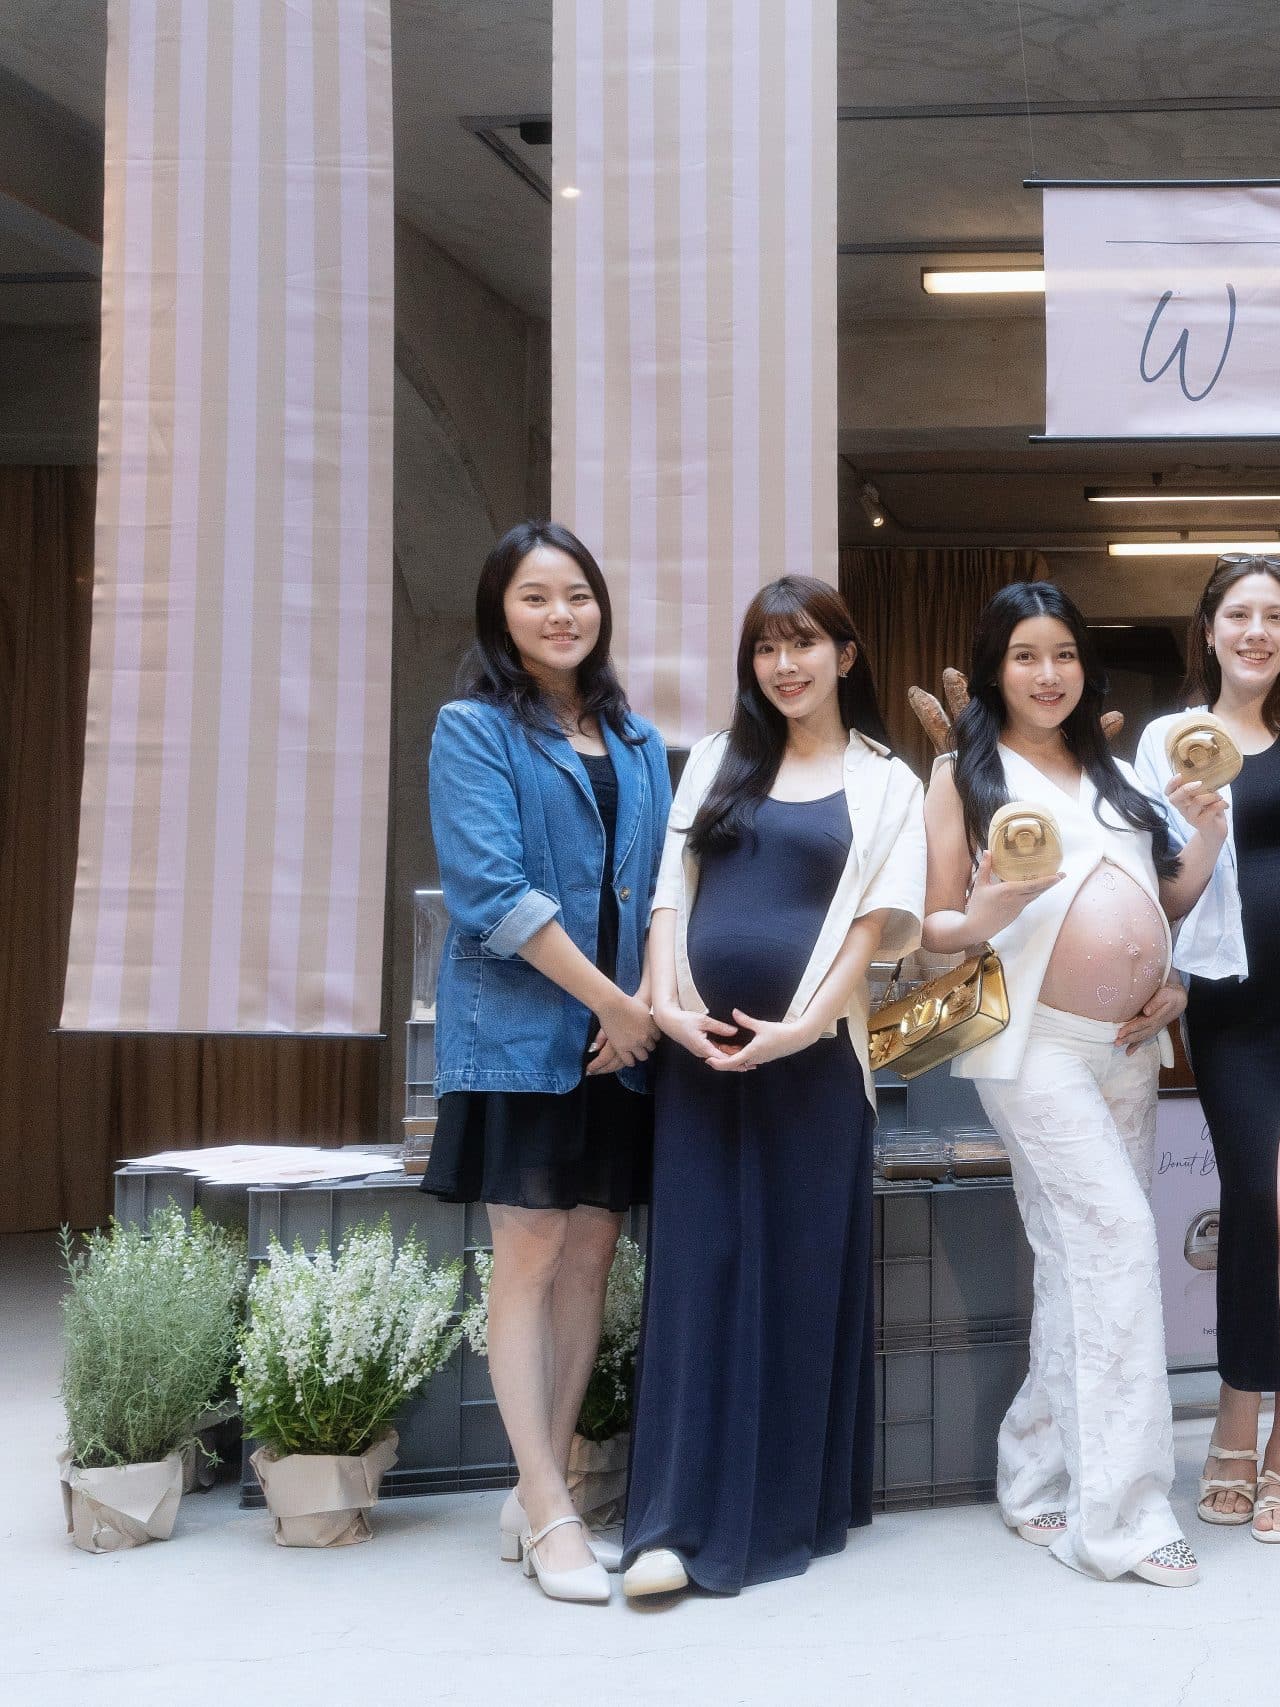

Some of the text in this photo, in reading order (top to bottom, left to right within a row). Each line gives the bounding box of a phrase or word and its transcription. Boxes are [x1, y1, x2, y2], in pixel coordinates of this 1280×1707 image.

[1139, 283, 1237, 402] W
[1158, 1151, 1204, 1175] Donut
[1203, 1327, 1217, 1336] heg
